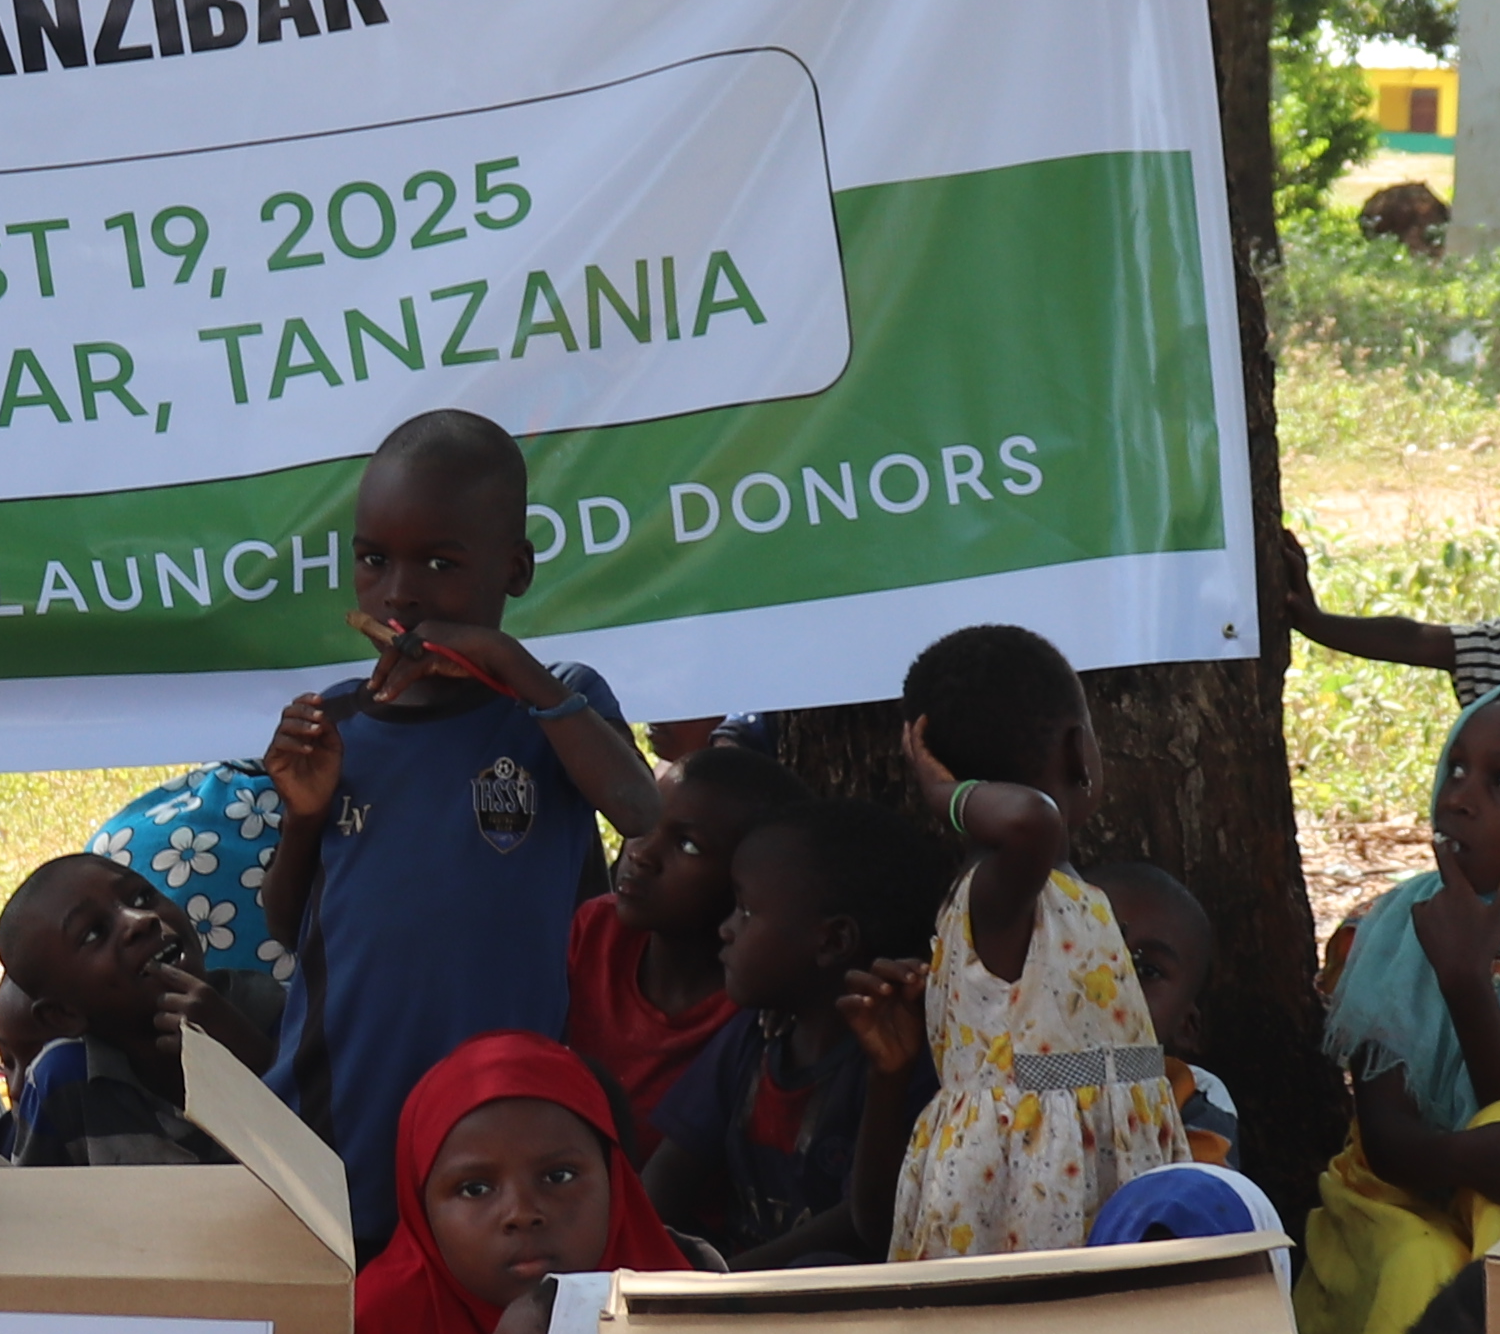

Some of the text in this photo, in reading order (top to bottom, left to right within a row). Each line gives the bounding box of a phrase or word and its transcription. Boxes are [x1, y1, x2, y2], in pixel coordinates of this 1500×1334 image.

[104, 205, 227, 299] 19,
[260, 156, 533, 273] 2025
[198, 250, 767, 405] TANZANIA
[527, 497, 631, 564] OD
[670, 434, 1045, 545] DONORS
